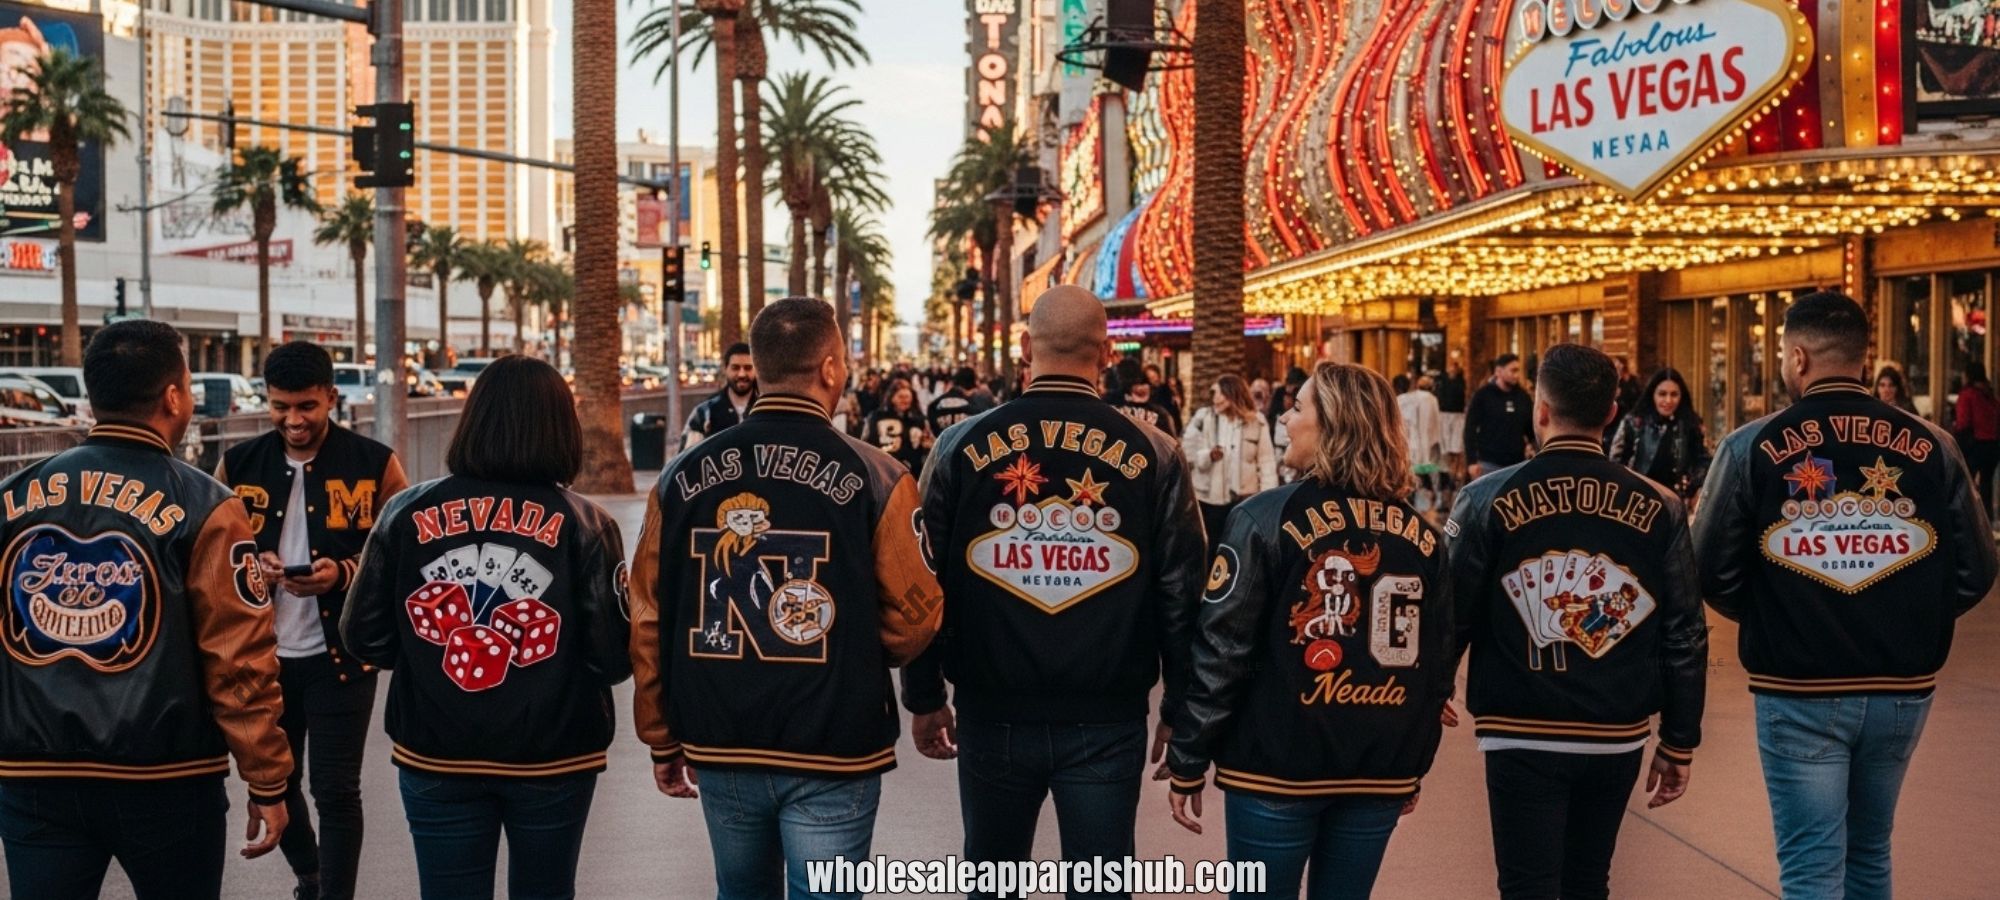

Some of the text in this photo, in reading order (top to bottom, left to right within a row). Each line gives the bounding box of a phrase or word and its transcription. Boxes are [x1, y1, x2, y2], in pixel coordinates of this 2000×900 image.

[1530, 46, 1746, 134] LAS VEGAS
[963, 420, 1148, 480] LAS VEGAS
[1760, 415, 1932, 464] LAS VEGAS
[3, 472, 69, 522] LAS
[675, 444, 863, 505] LAS VEGAS
[325, 479, 377, 529] M
[412, 496, 565, 548] NEVADA
[1283, 498, 1437, 557] LAS VEGAS
[993, 543, 1110, 572] LAS VEGAS
[1783, 533, 1910, 556] LAS VEGAS
[1300, 669, 1407, 705] Neada
